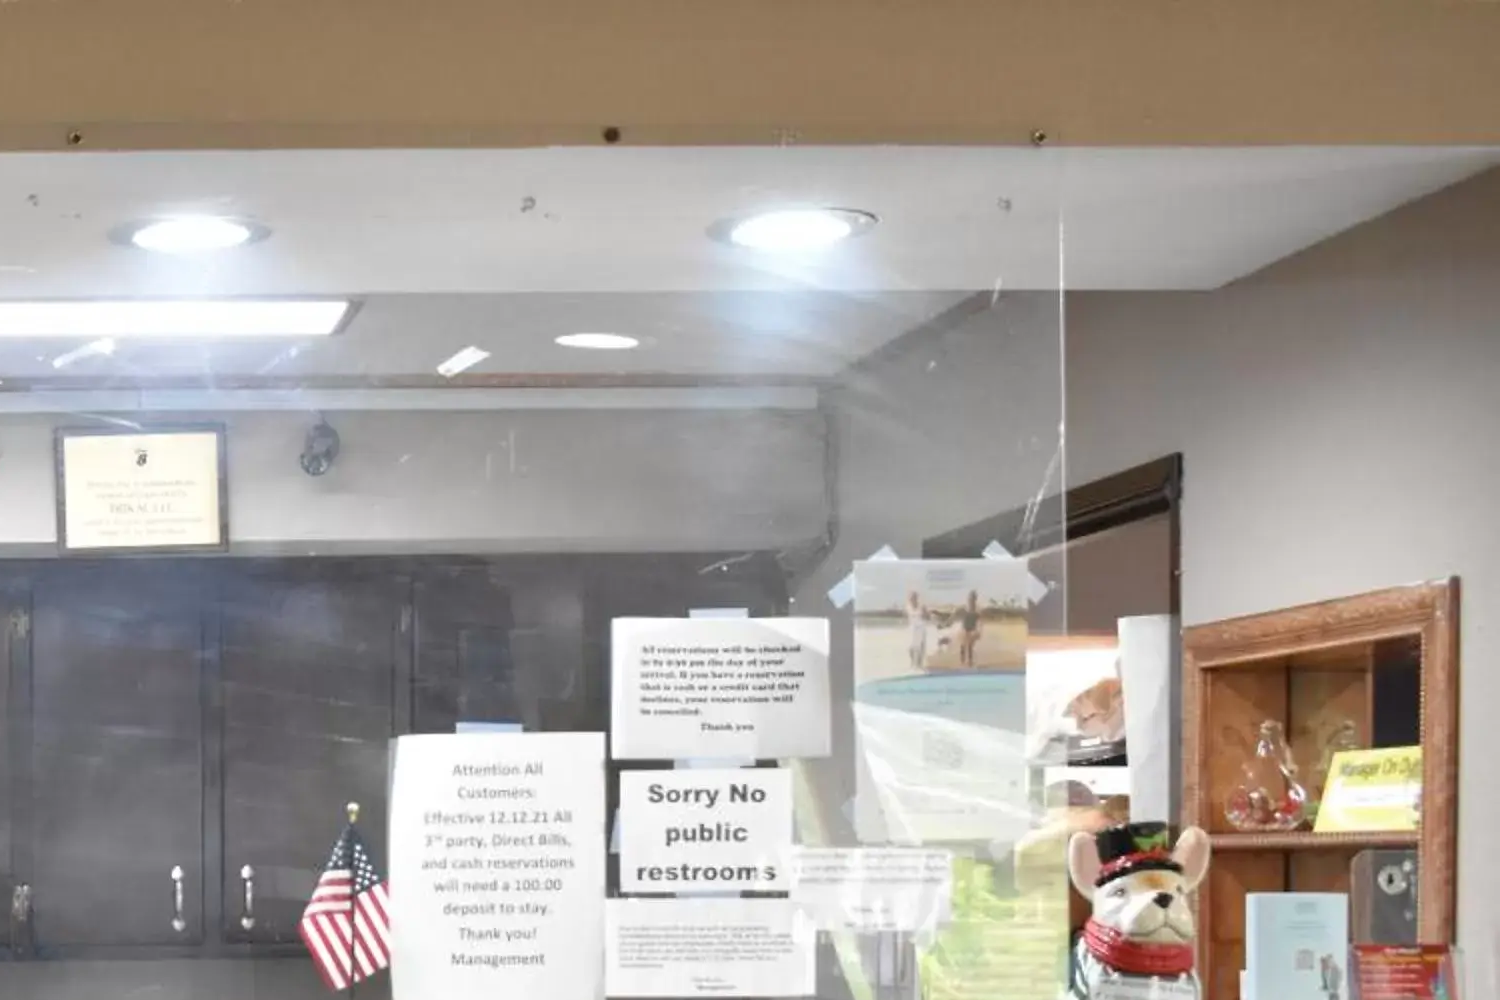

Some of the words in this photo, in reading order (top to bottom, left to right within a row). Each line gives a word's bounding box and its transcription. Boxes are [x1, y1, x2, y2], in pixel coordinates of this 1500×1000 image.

[452, 763, 520, 777] Attention
[524, 762, 544, 776] All
[457, 786, 537, 800] Customers:
[647, 783, 719, 809] Sorry
[729, 783, 767, 803] No
[423, 810, 486, 825] Effective
[489, 811, 549, 824] 12.12.21
[553, 810, 573, 824] All
[491, 834, 535, 847] Direct
[665, 822, 749, 847] public
[421, 857, 448, 870] and
[451, 857, 484, 869] cash
[487, 857, 576, 869] reservations
[636, 863, 778, 881] restrooms
[433, 879, 459, 892] will
[462, 879, 498, 892] need
[442, 903, 496, 917] deposit
[500, 903, 515, 915] to
[458, 927, 501, 941] Thank
[505, 927, 538, 941] you!
[451, 953, 546, 968] Management
